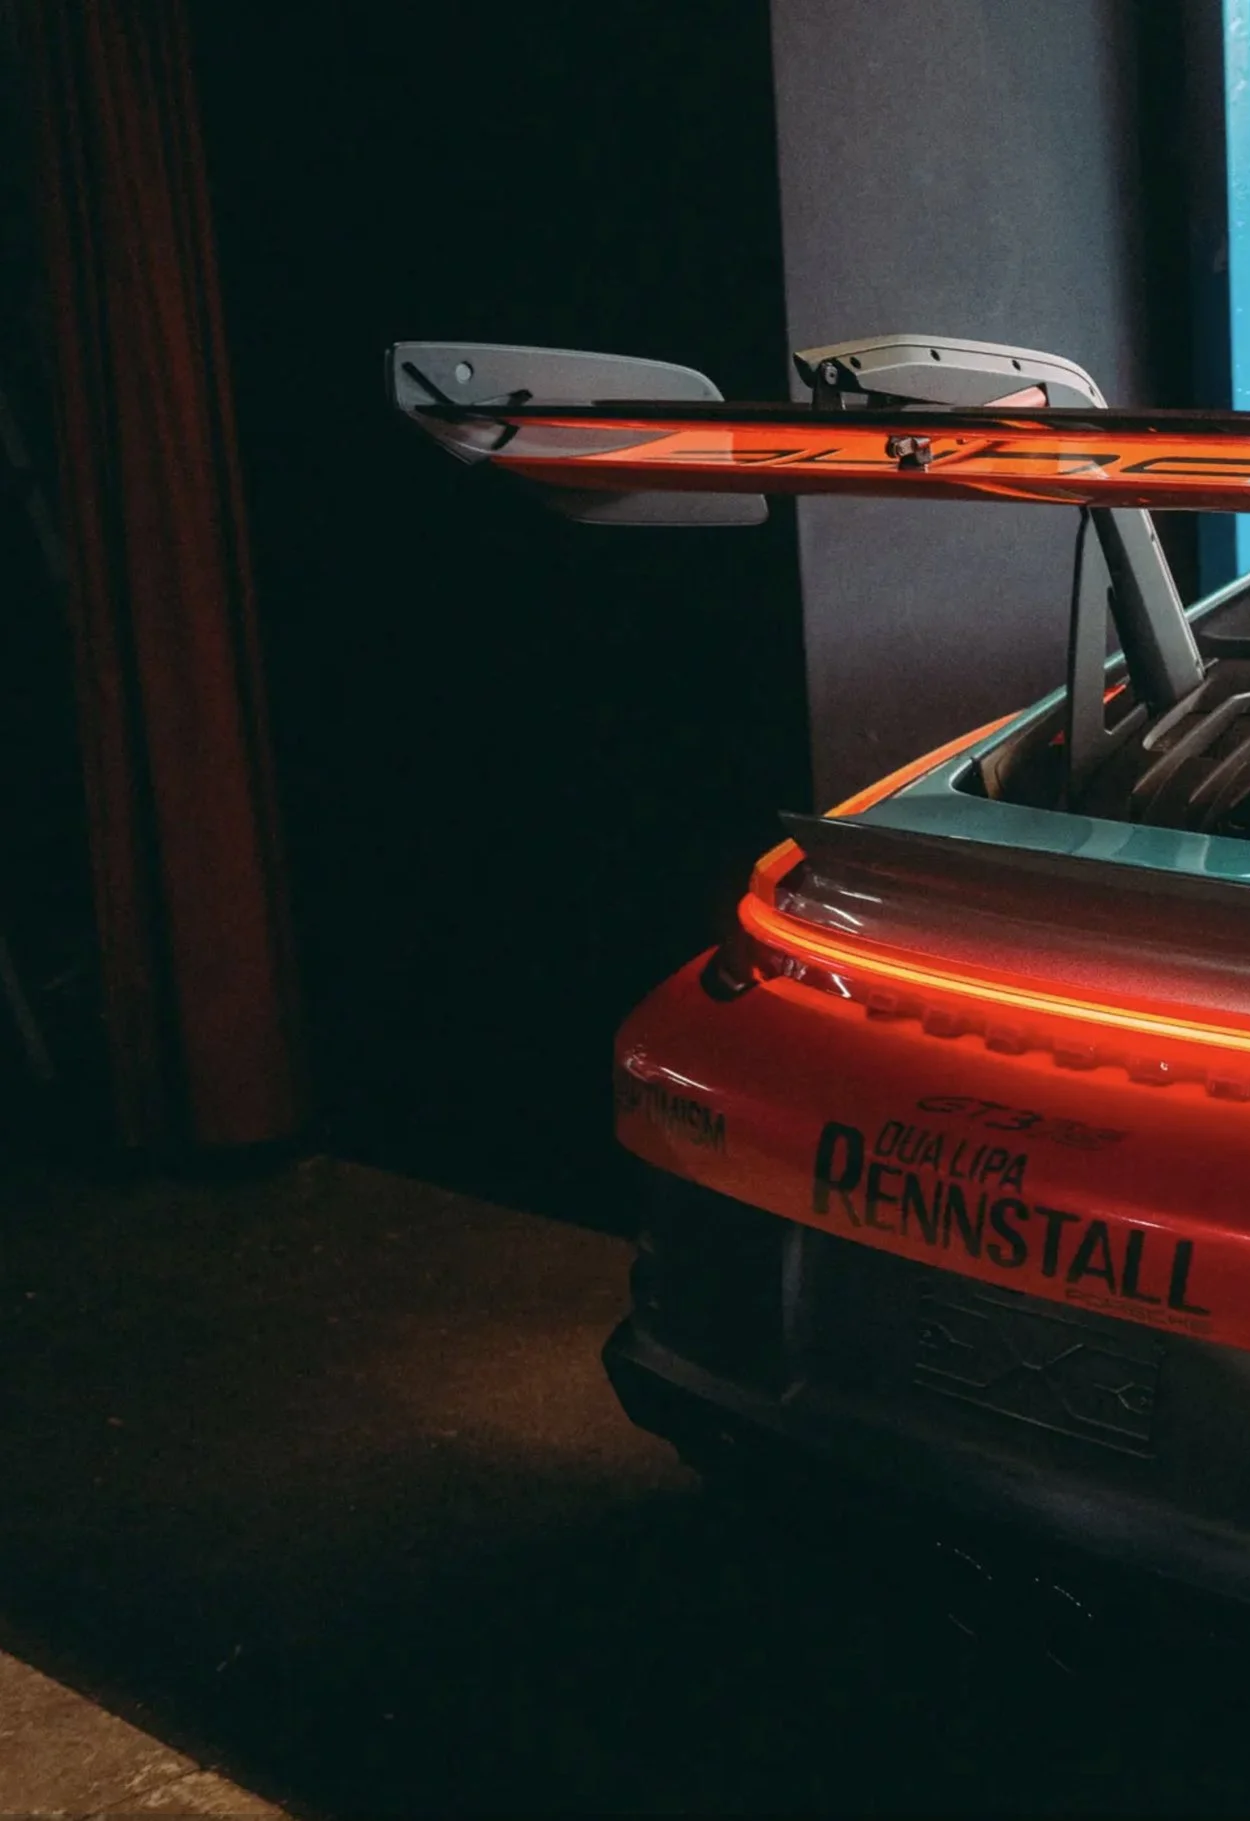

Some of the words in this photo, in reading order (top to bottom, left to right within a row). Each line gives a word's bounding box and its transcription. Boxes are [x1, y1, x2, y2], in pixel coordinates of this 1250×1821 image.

[916, 1096, 1043, 1130] GT3
[874, 1119, 945, 1171] DUA
[949, 1138, 1029, 1194] LIPA
[811, 1120, 1212, 1316] RENNSTALL
